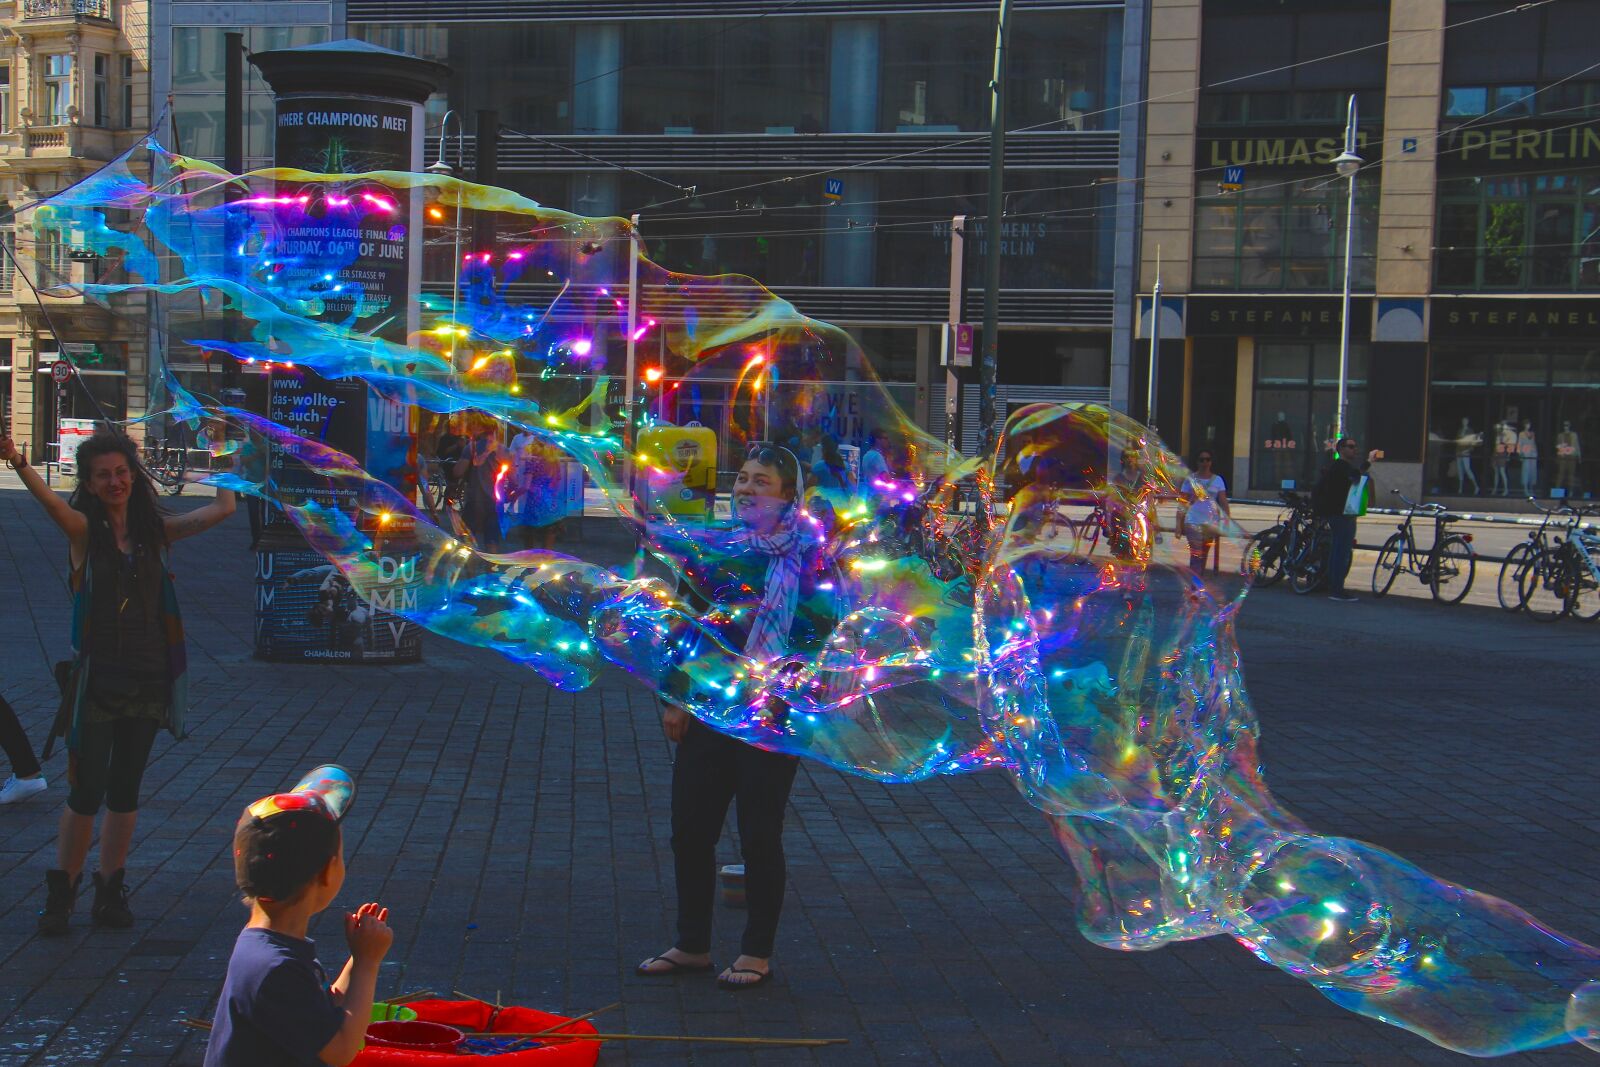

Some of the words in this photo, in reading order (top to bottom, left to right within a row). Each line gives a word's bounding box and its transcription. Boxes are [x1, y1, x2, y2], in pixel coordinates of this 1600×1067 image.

[278, 112, 304, 127] WHERE
[306, 111, 379, 128] CHAMPIONS
[382, 115, 407, 132] MEET
[1211, 137, 1337, 166] LUMAS
[1228, 169, 1242, 182] W
[829, 179, 841, 194] W
[287, 227, 330, 237] CHAMPIONS
[332, 228, 363, 239] LEAGUE
[365, 230, 388, 240] FINAL
[975, 222, 1047, 238] WMEN'S
[328, 240, 355, 255] 06TH
[358, 242, 375, 257] OF
[379, 244, 404, 260] JUNE
[980, 240, 1036, 256] BRLIN
[351, 270, 377, 280] STRASSE
[1449, 312, 1599, 324] STEFANEL
[55, 366, 68, 377] 30
[273, 379, 302, 389] www.
[1264, 438, 1297, 449] sale
